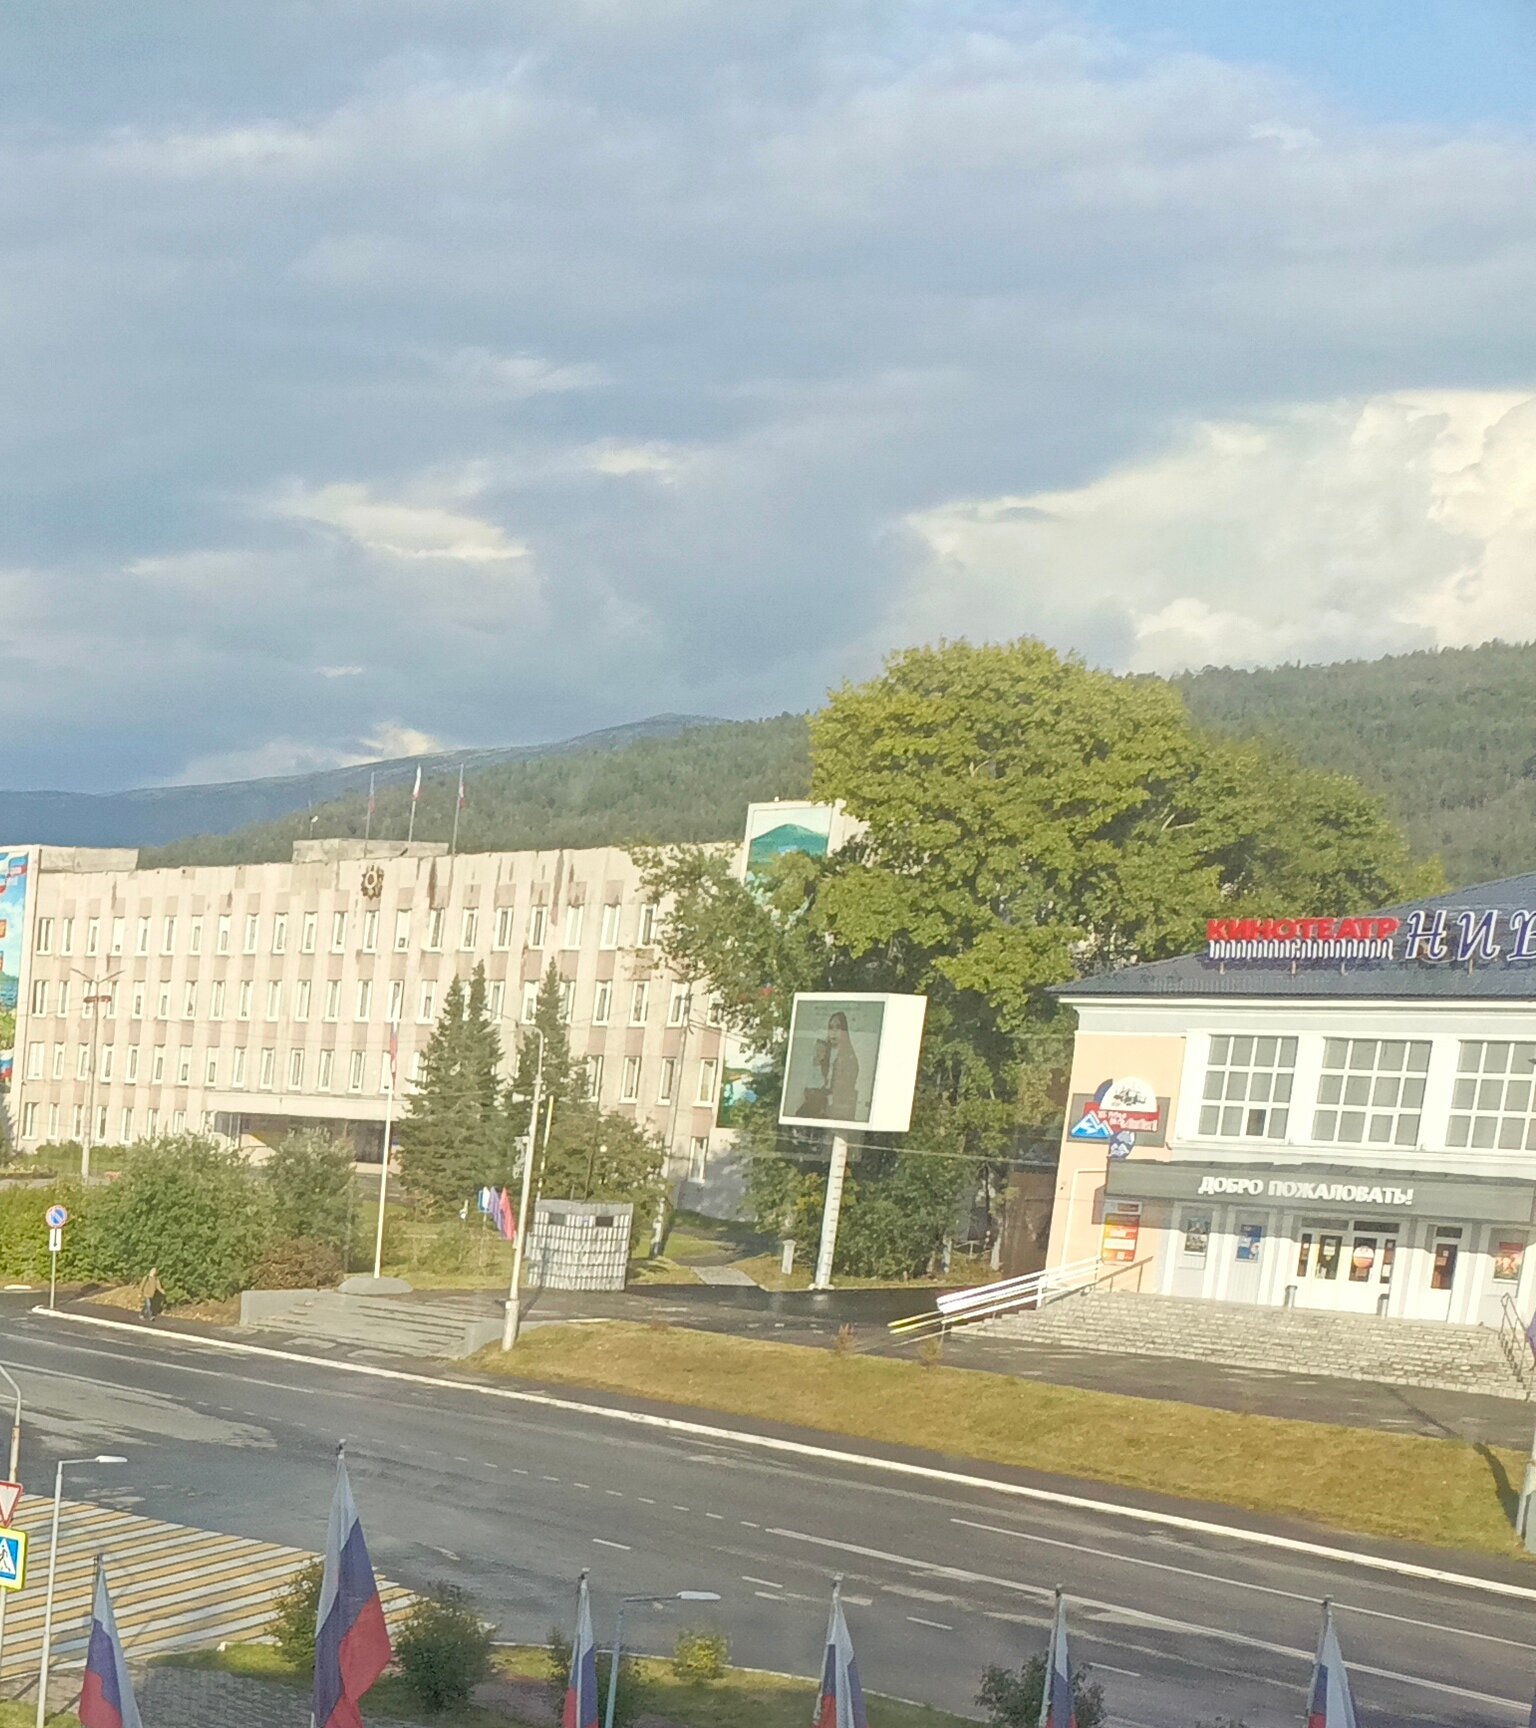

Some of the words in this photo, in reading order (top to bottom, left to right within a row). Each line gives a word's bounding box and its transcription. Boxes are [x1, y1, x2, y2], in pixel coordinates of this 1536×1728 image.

[1206, 917, 1400, 940] КИНОТЕАТР
[1197, 1176, 1264, 1196] ДОБРО
[1267, 1180, 1414, 1206] ПОЖАЛОВАТЬ!
